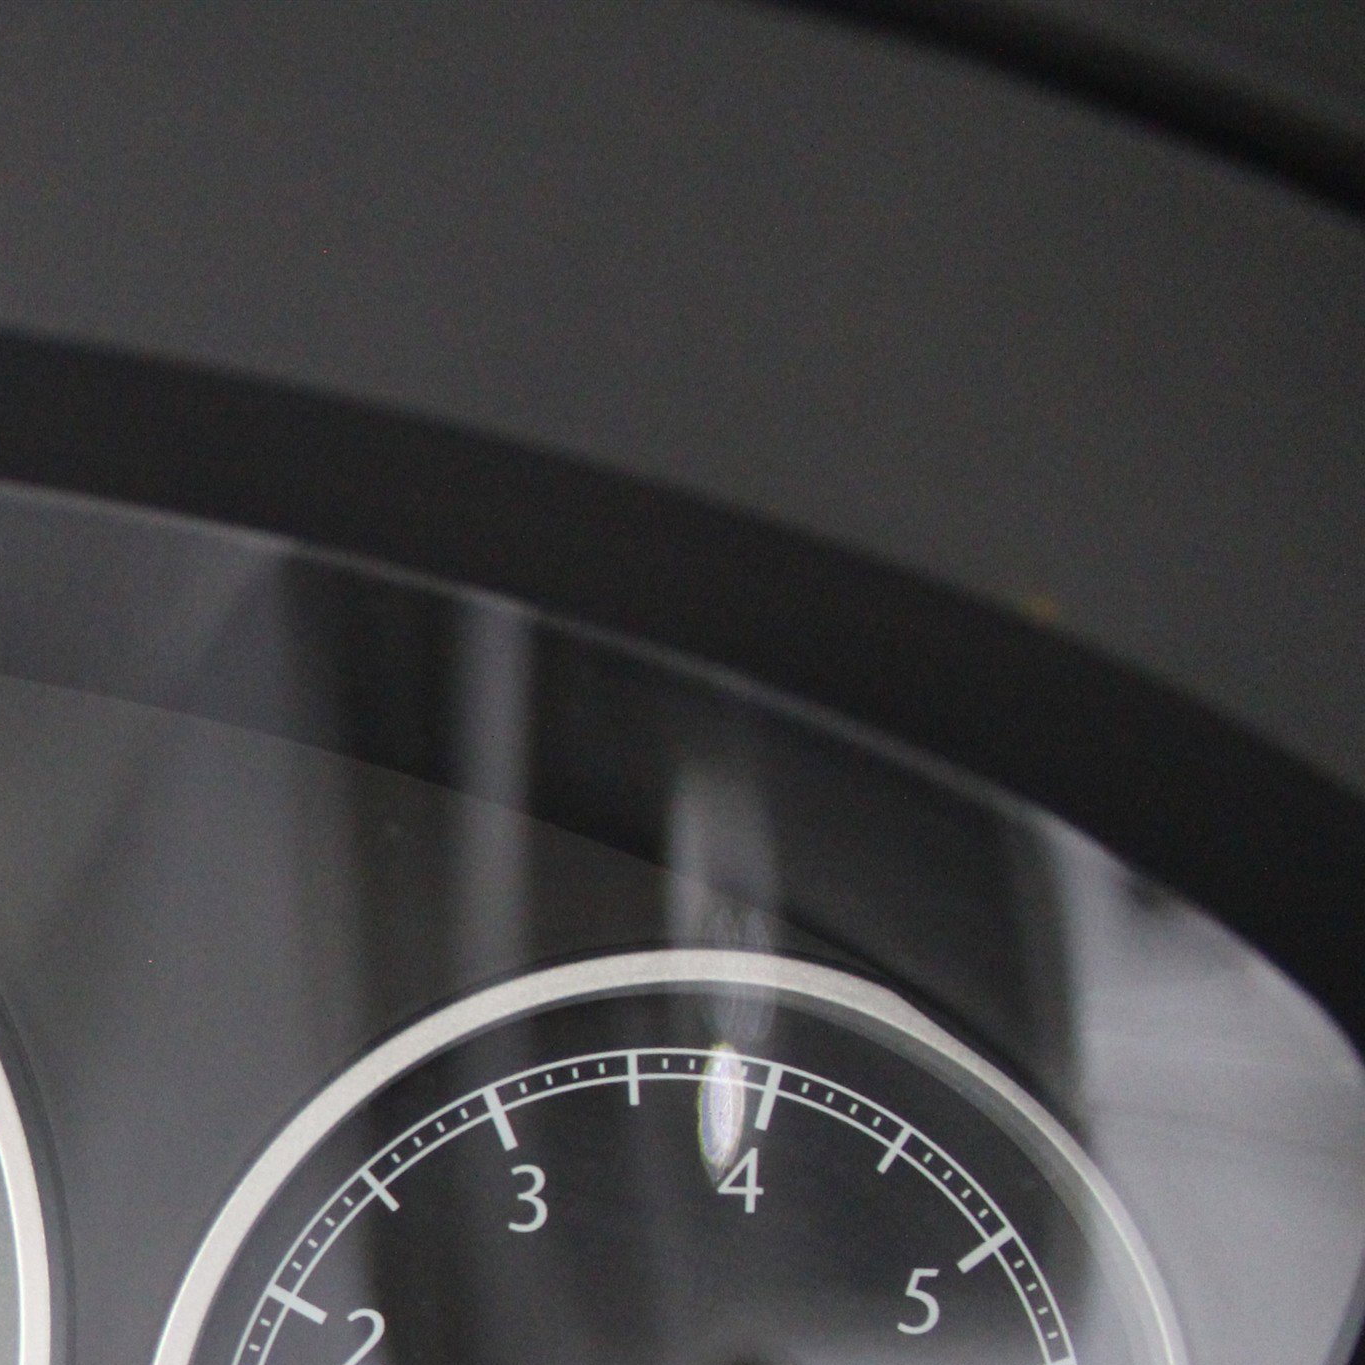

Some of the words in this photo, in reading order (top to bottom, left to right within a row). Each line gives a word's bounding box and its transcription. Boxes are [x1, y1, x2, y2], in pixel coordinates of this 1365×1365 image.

[508, 1165, 548, 1232] 3
[717, 1148, 763, 1212] 4
[897, 1268, 939, 1335] 5
